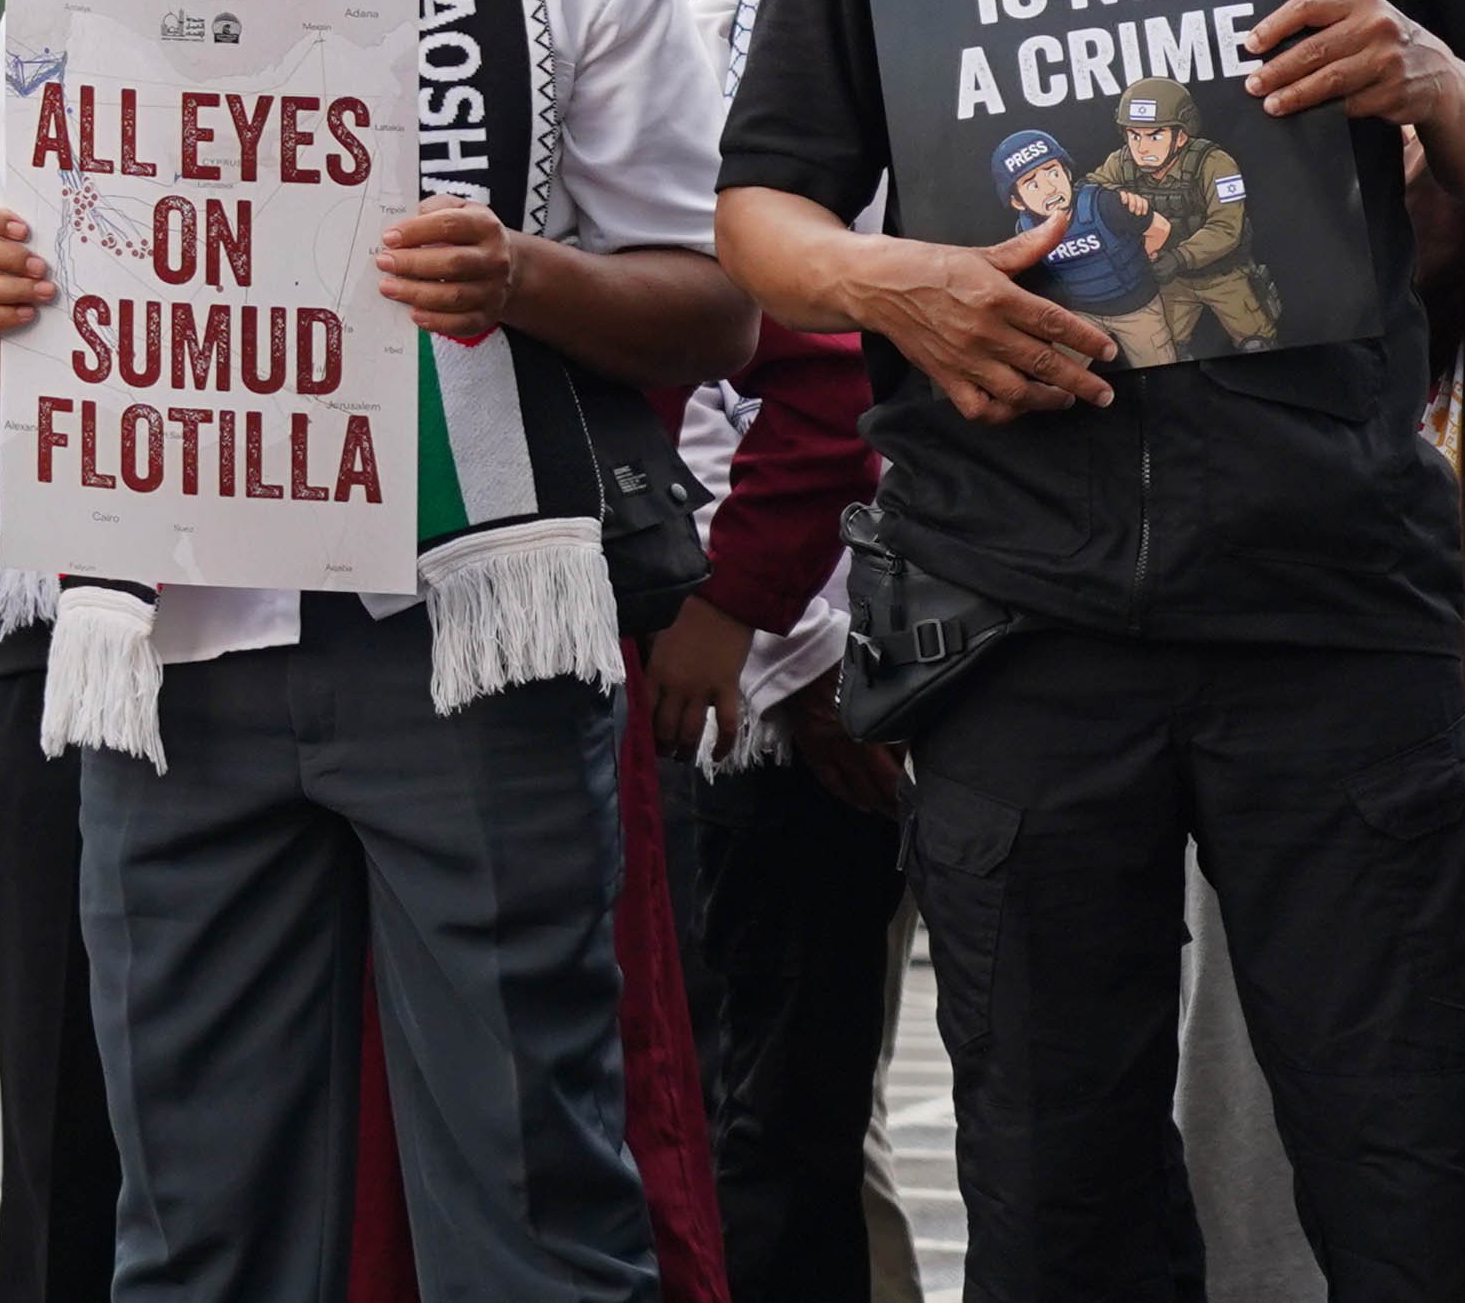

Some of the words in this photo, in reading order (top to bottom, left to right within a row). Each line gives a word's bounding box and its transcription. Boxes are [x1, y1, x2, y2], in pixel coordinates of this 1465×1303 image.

[345, 7, 379, 19] Adana
[957, 46, 1007, 119] A
[1017, 2, 1264, 108] CRIME
[32, 81, 157, 178] ALL
[180, 91, 372, 187] EYES
[1004, 140, 1048, 172] PRESS
[152, 194, 253, 288] ON
[71, 294, 344, 396] SUMUD
[37, 395, 384, 504] FLOTILLA
[92, 511, 120, 524] Cairo
